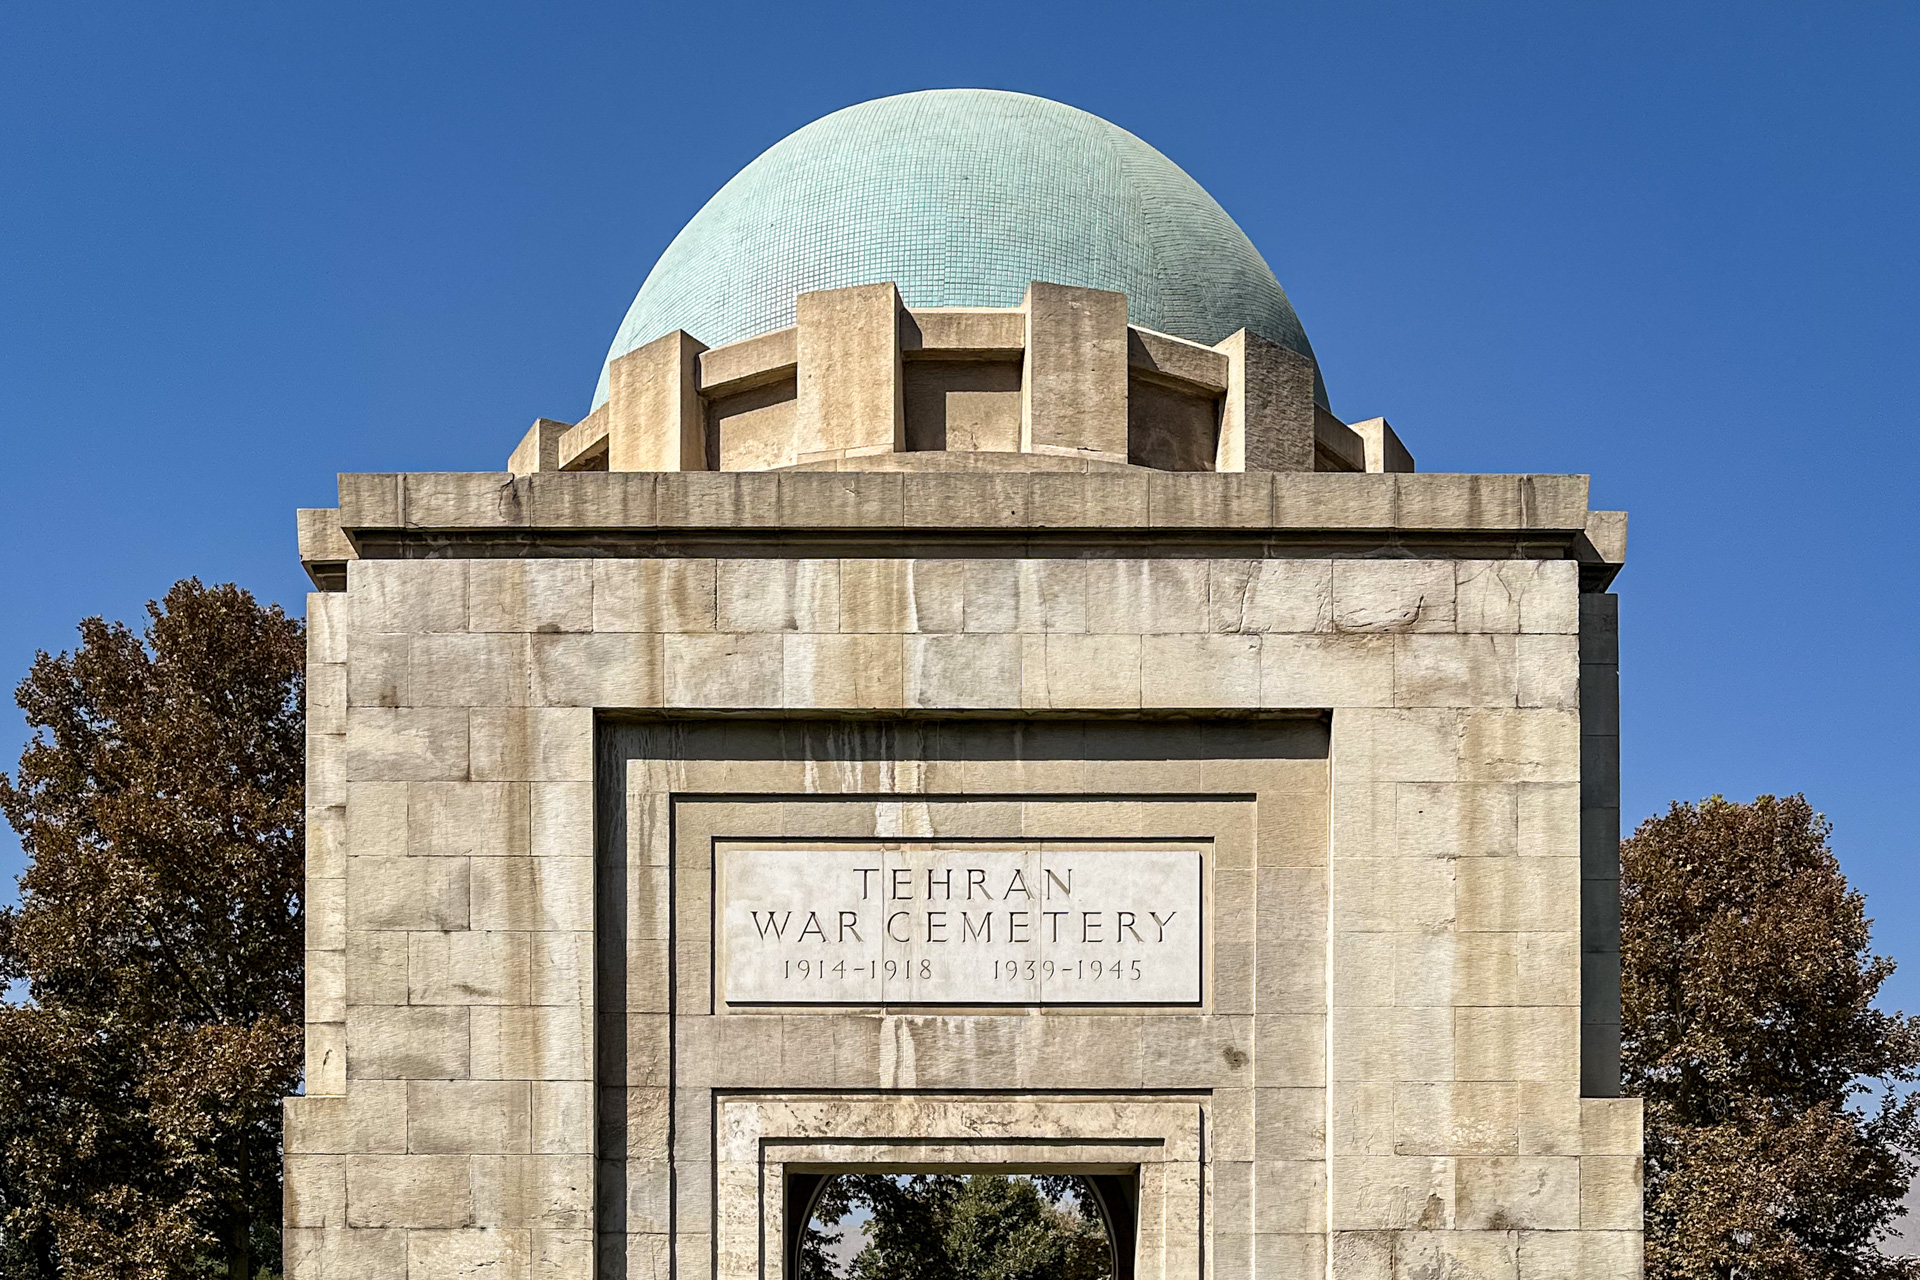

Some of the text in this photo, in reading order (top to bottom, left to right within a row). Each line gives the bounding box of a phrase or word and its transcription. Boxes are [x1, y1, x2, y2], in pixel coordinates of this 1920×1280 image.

[852, 868, 1073, 901] TEHRAN
[750, 911, 1177, 943] WAR CEMETERY
[784, 959, 1143, 982] 1914-1918 1939-1945
